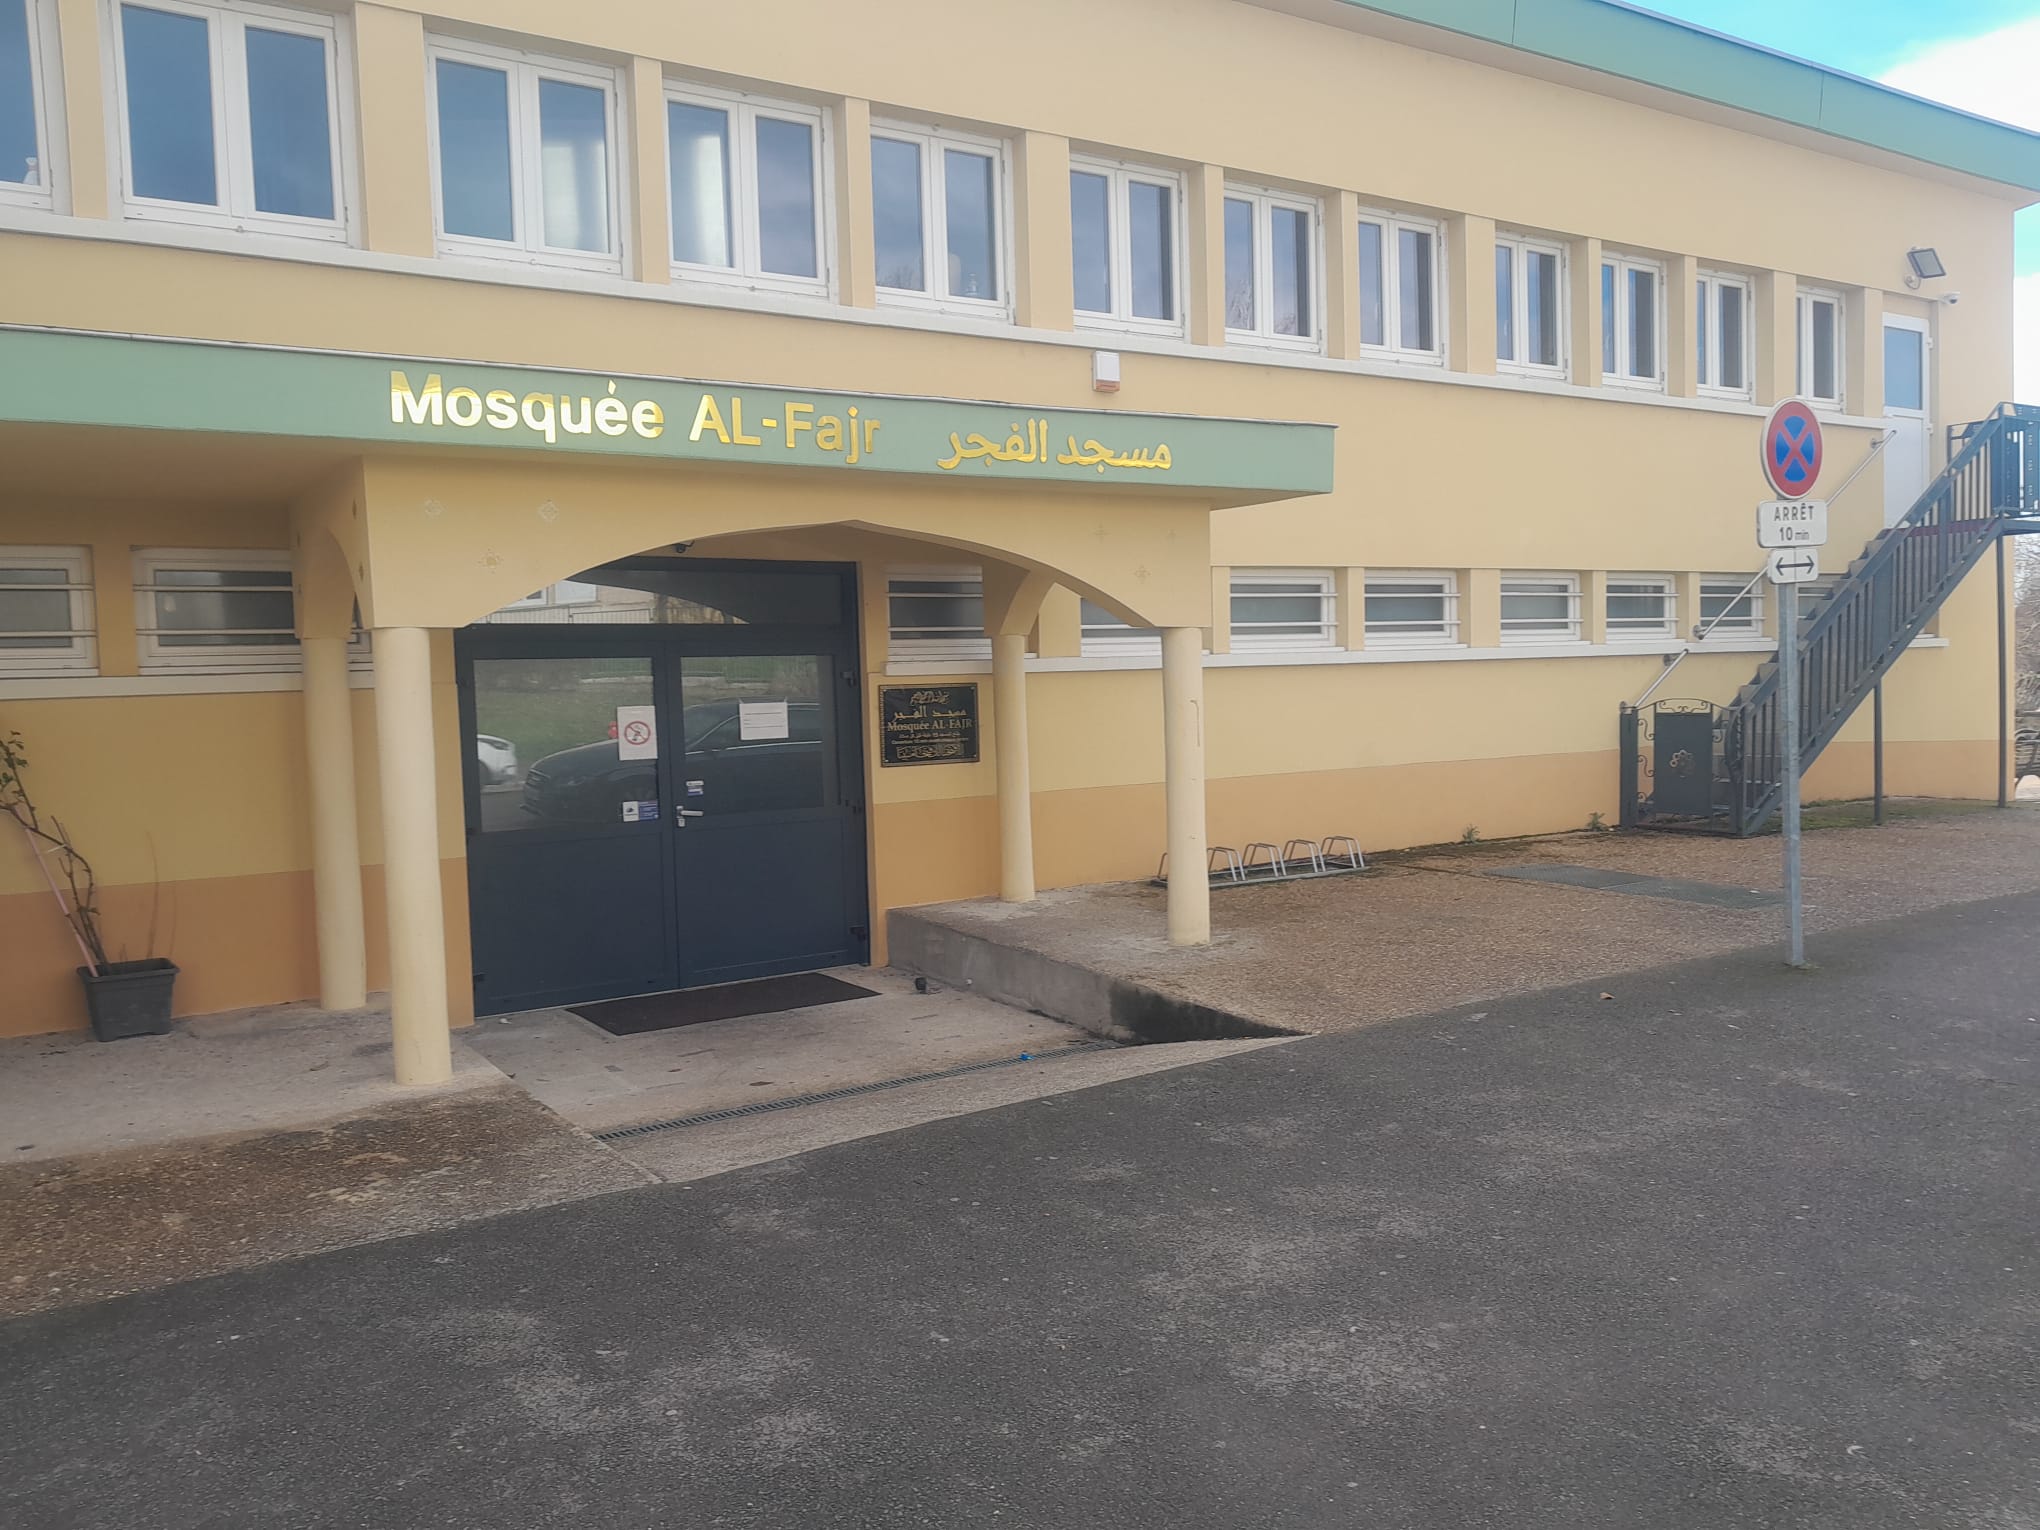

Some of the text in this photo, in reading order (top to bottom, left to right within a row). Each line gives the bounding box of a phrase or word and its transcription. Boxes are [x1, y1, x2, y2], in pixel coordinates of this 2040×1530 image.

[390, 370, 880, 464] Mosquée AL-Fajr
[936, 418, 1172, 473] مسجد الفجر
[1774, 503, 1815, 521] ARRÊT
[1779, 526, 1793, 541] 10
